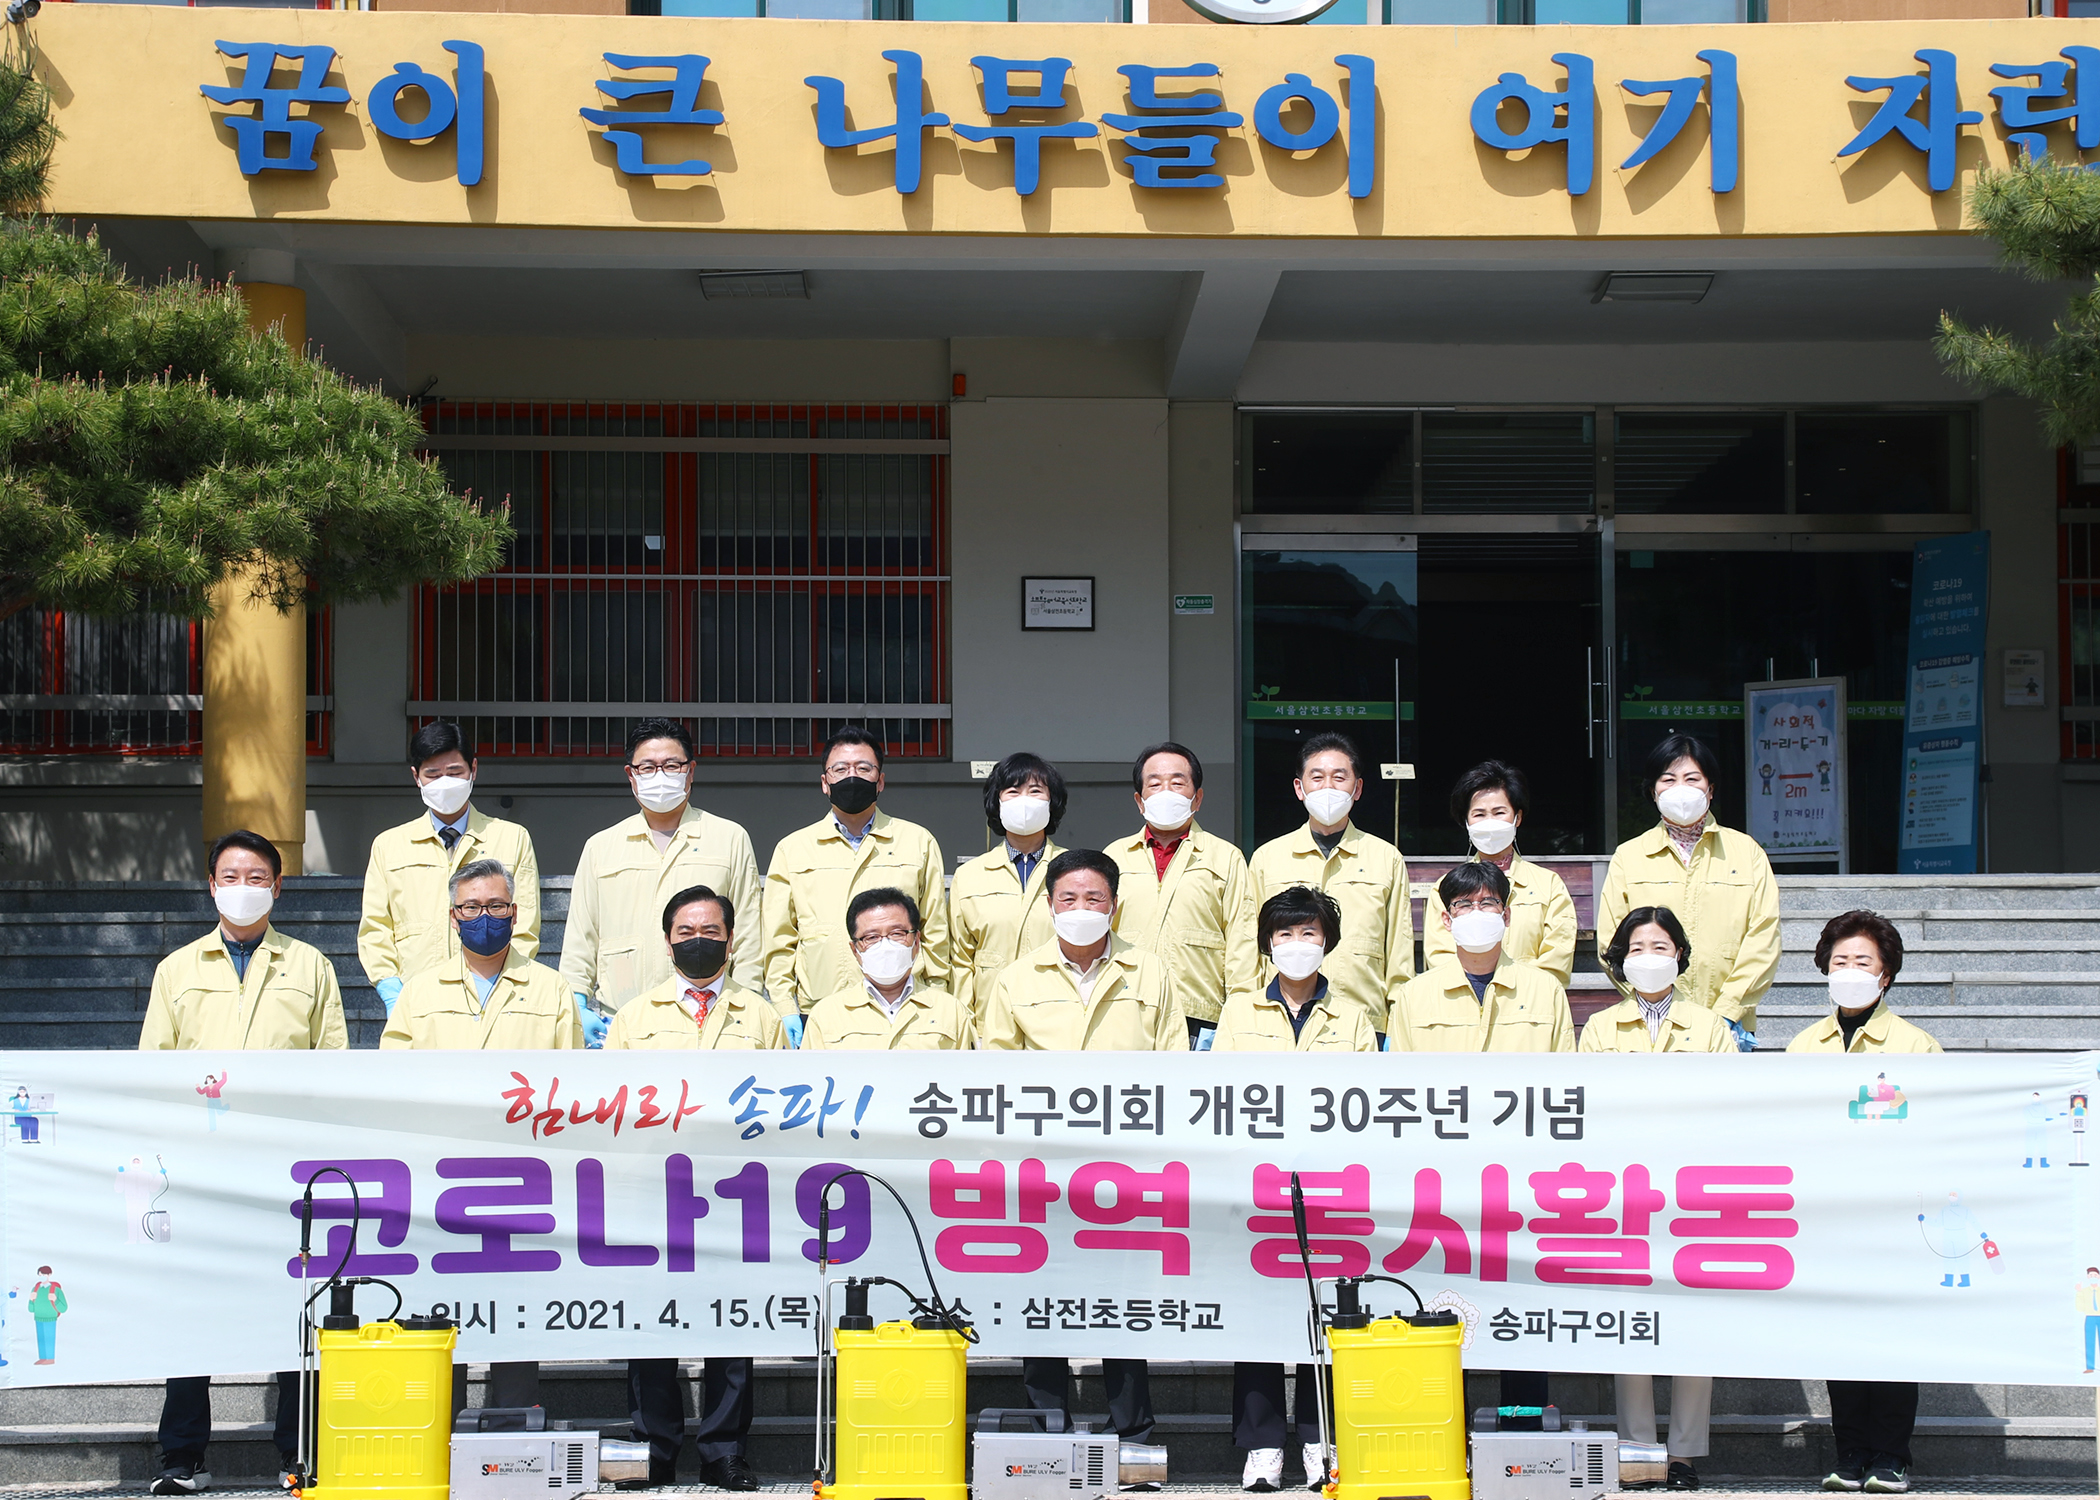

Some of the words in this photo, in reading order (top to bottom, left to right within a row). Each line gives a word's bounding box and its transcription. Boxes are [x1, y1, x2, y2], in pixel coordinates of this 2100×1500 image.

[200, 39, 484, 187] 꿈이
[580, 52, 725, 177] 큰
[804, 50, 1375, 199] 나무들이
[1470, 50, 1738, 196] 여기
[1932, 578, 1962, 591] 코로나19
[1275, 705, 1368, 716] 서울삼전초등학교
[1648, 705, 1741, 716] 서울삼전초등학교
[1773, 715, 1814, 730] 사회적
[1784, 783, 1808, 799] 2m
[502, 1071, 706, 1140] 힘내라
[728, 1075, 874, 1140] 송파!
[909, 1082, 1164, 1139] 송파구의회
[1189, 1084, 1284, 1139] 개원
[1310, 1086, 1470, 1140] 30주년
[1492, 1086, 1585, 1140] 기념
[287, 1153, 872, 1278] 코로나19
[928, 1157, 1191, 1276] 방역
[1246, 1162, 1799, 1291] 봉사활동
[545, 1299, 641, 1331] 2021.
[658, 1299, 690, 1329] 4.
[1021, 1297, 1224, 1333] 삼전초등학교
[1489, 1307, 1660, 1346] 송파구의회
